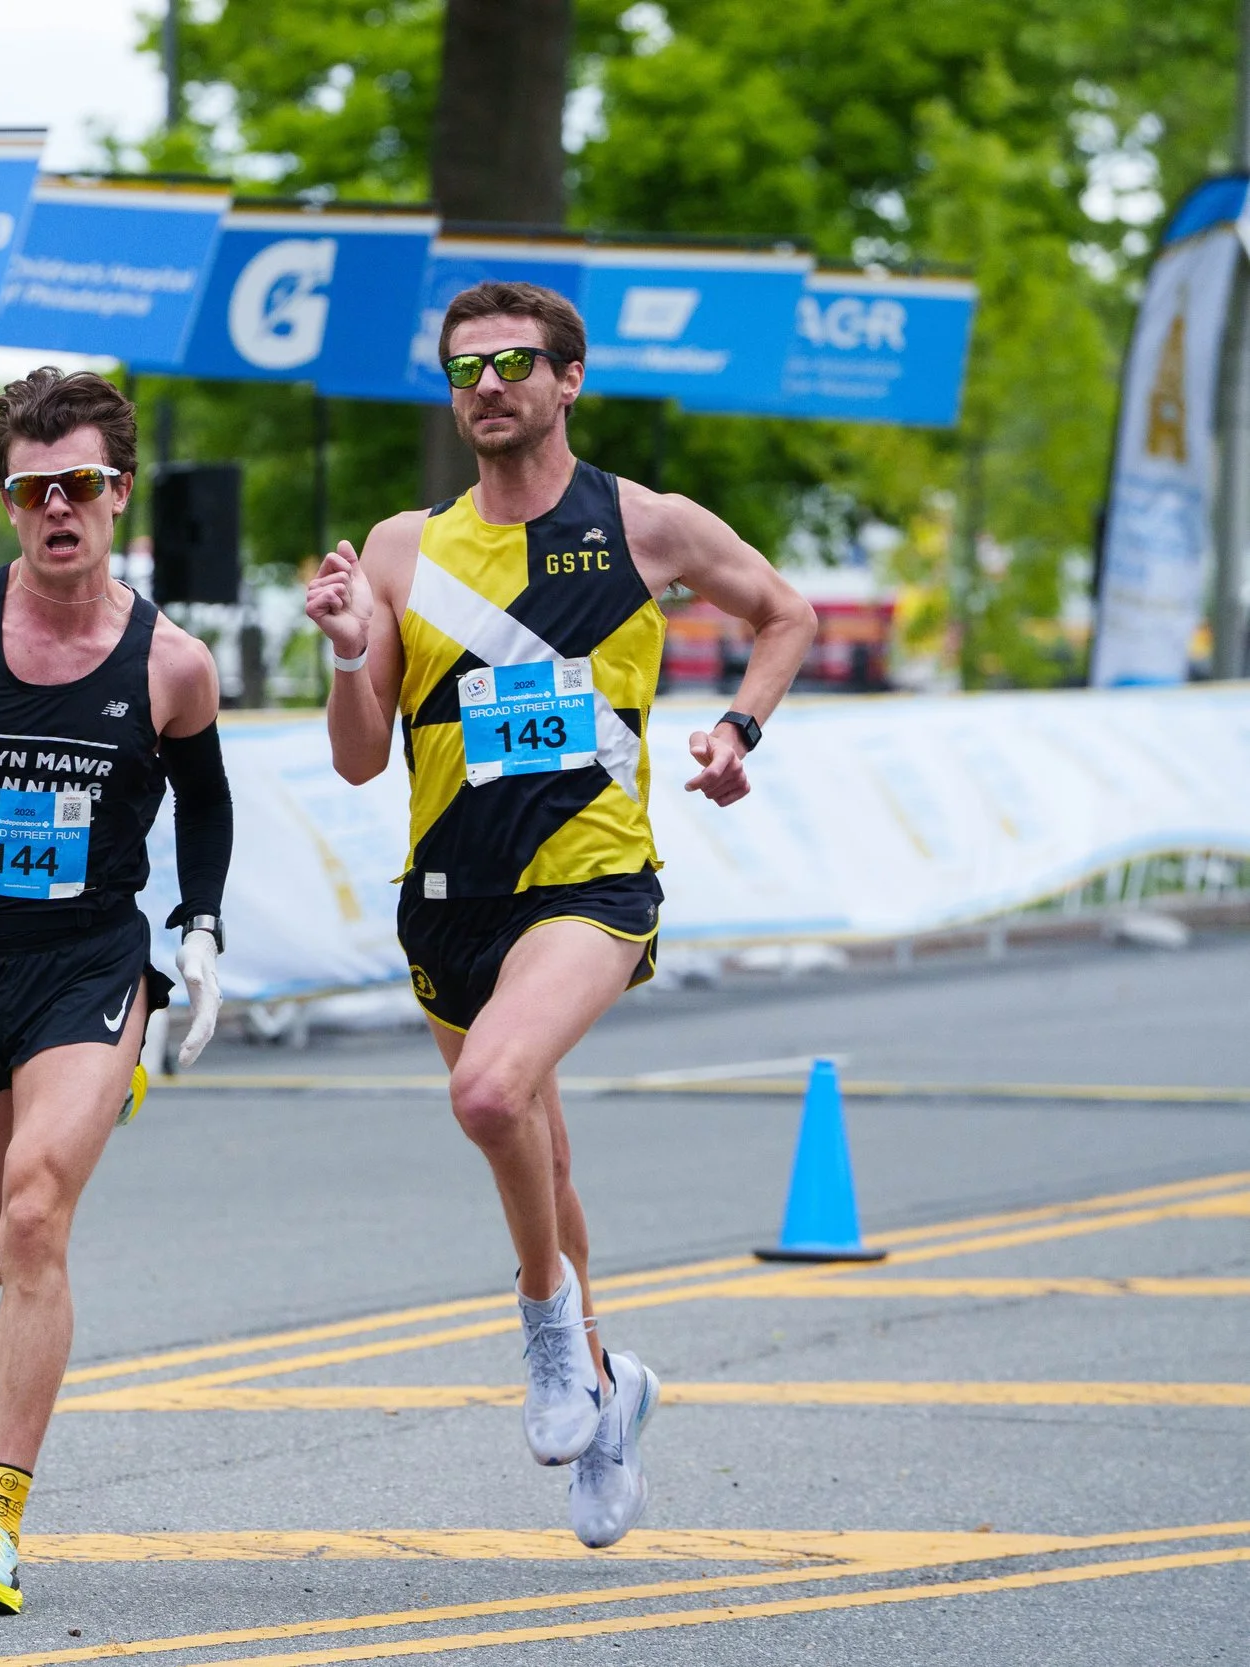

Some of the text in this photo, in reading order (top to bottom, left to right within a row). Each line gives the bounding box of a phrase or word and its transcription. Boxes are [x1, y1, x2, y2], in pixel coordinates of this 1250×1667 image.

[228, 237, 338, 370] G
[546, 550, 610, 574] GSTC
[514, 680, 536, 690] 2026
[500, 692, 543, 702] Independence
[470, 698, 584, 718] BROAD STREET RUN
[495, 716, 566, 752] 143
[35, 752, 113, 777] MAWR
[14, 808, 36, 816] 2026
[0, 818, 42, 828] Independence
[10, 830, 53, 840] STREET
[56, 831, 80, 840] RUN
